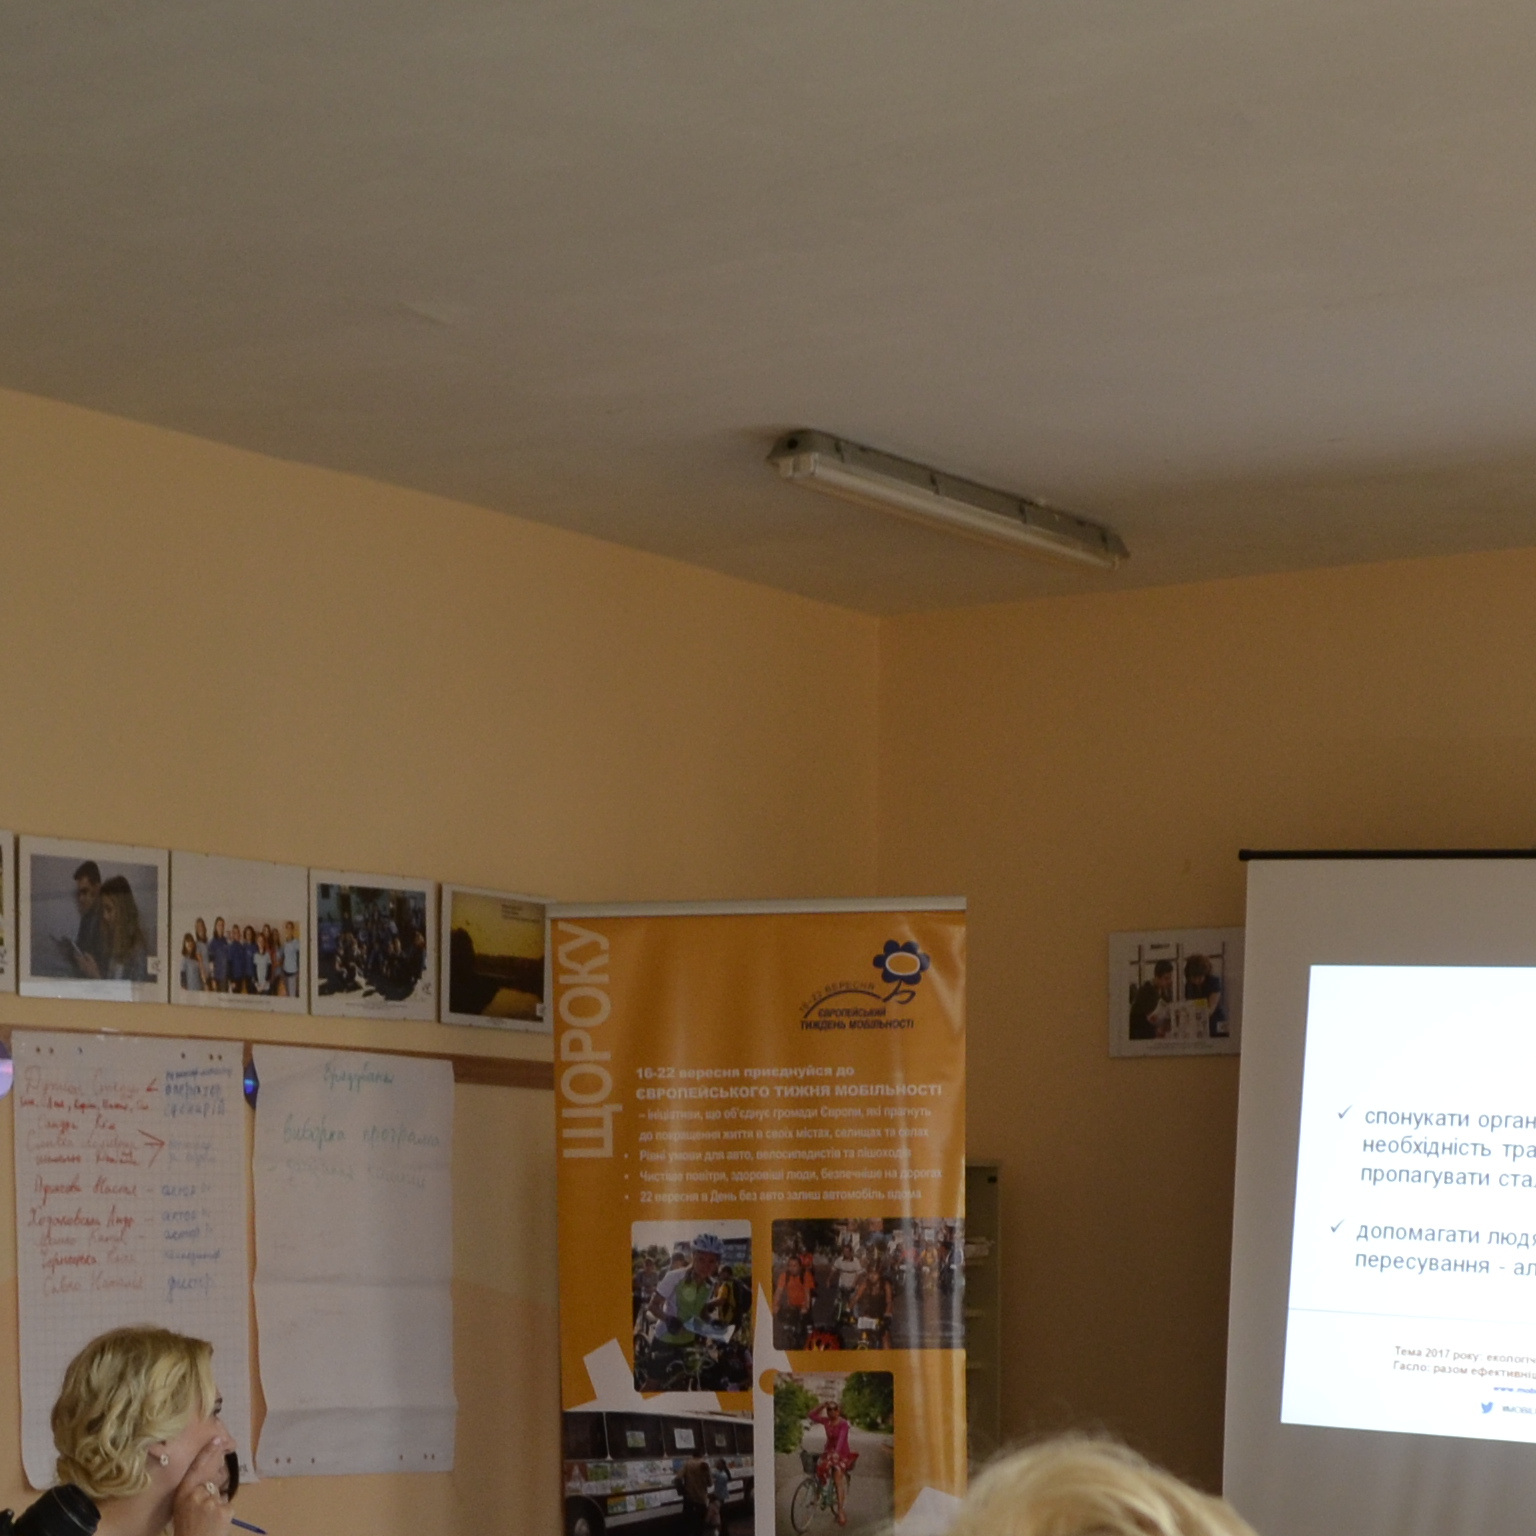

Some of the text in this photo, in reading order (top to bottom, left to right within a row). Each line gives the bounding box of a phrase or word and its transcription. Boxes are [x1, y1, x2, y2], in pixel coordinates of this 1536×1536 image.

[558, 921, 622, 1158] ЩОРОКУ
[636, 1065, 855, 1080] 16-22 вересня приєднуйся до
[636, 1084, 942, 1100] ЄВРОПЕЙСЬКОГО ТИЖНЯ МОБІЛЬНОСТІ
[1364, 1108, 1470, 1131] спонукати
[1363, 1136, 1492, 1158] необхідність
[1361, 1167, 1490, 1188] пропагувати
[1356, 1224, 1480, 1245] допомагати
[1355, 1252, 1490, 1275] пересування
[1395, 1345, 1422, 1357] Тема
[1425, 1348, 1450, 1359] 2017
[1453, 1351, 1483, 1363] року:
[1433, 1364, 1468, 1375] разом
